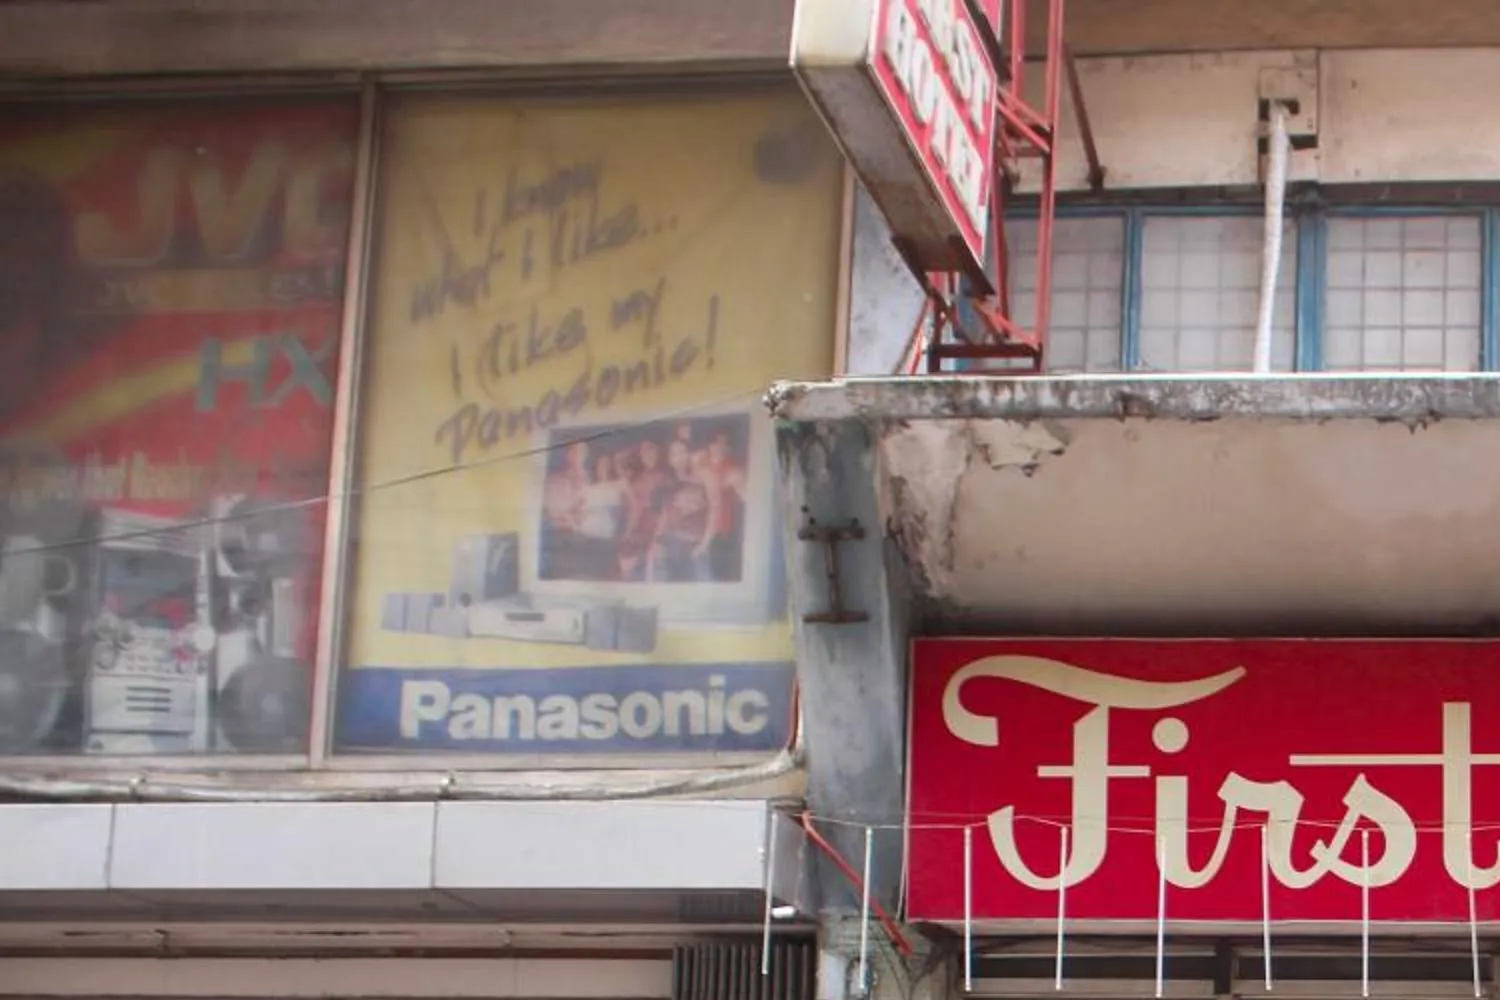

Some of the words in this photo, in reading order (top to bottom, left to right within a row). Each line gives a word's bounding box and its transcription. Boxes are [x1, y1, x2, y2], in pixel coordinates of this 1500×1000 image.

[489, 305, 588, 380] like
[611, 274, 668, 348] my
[402, 675, 769, 740] Panasonic
